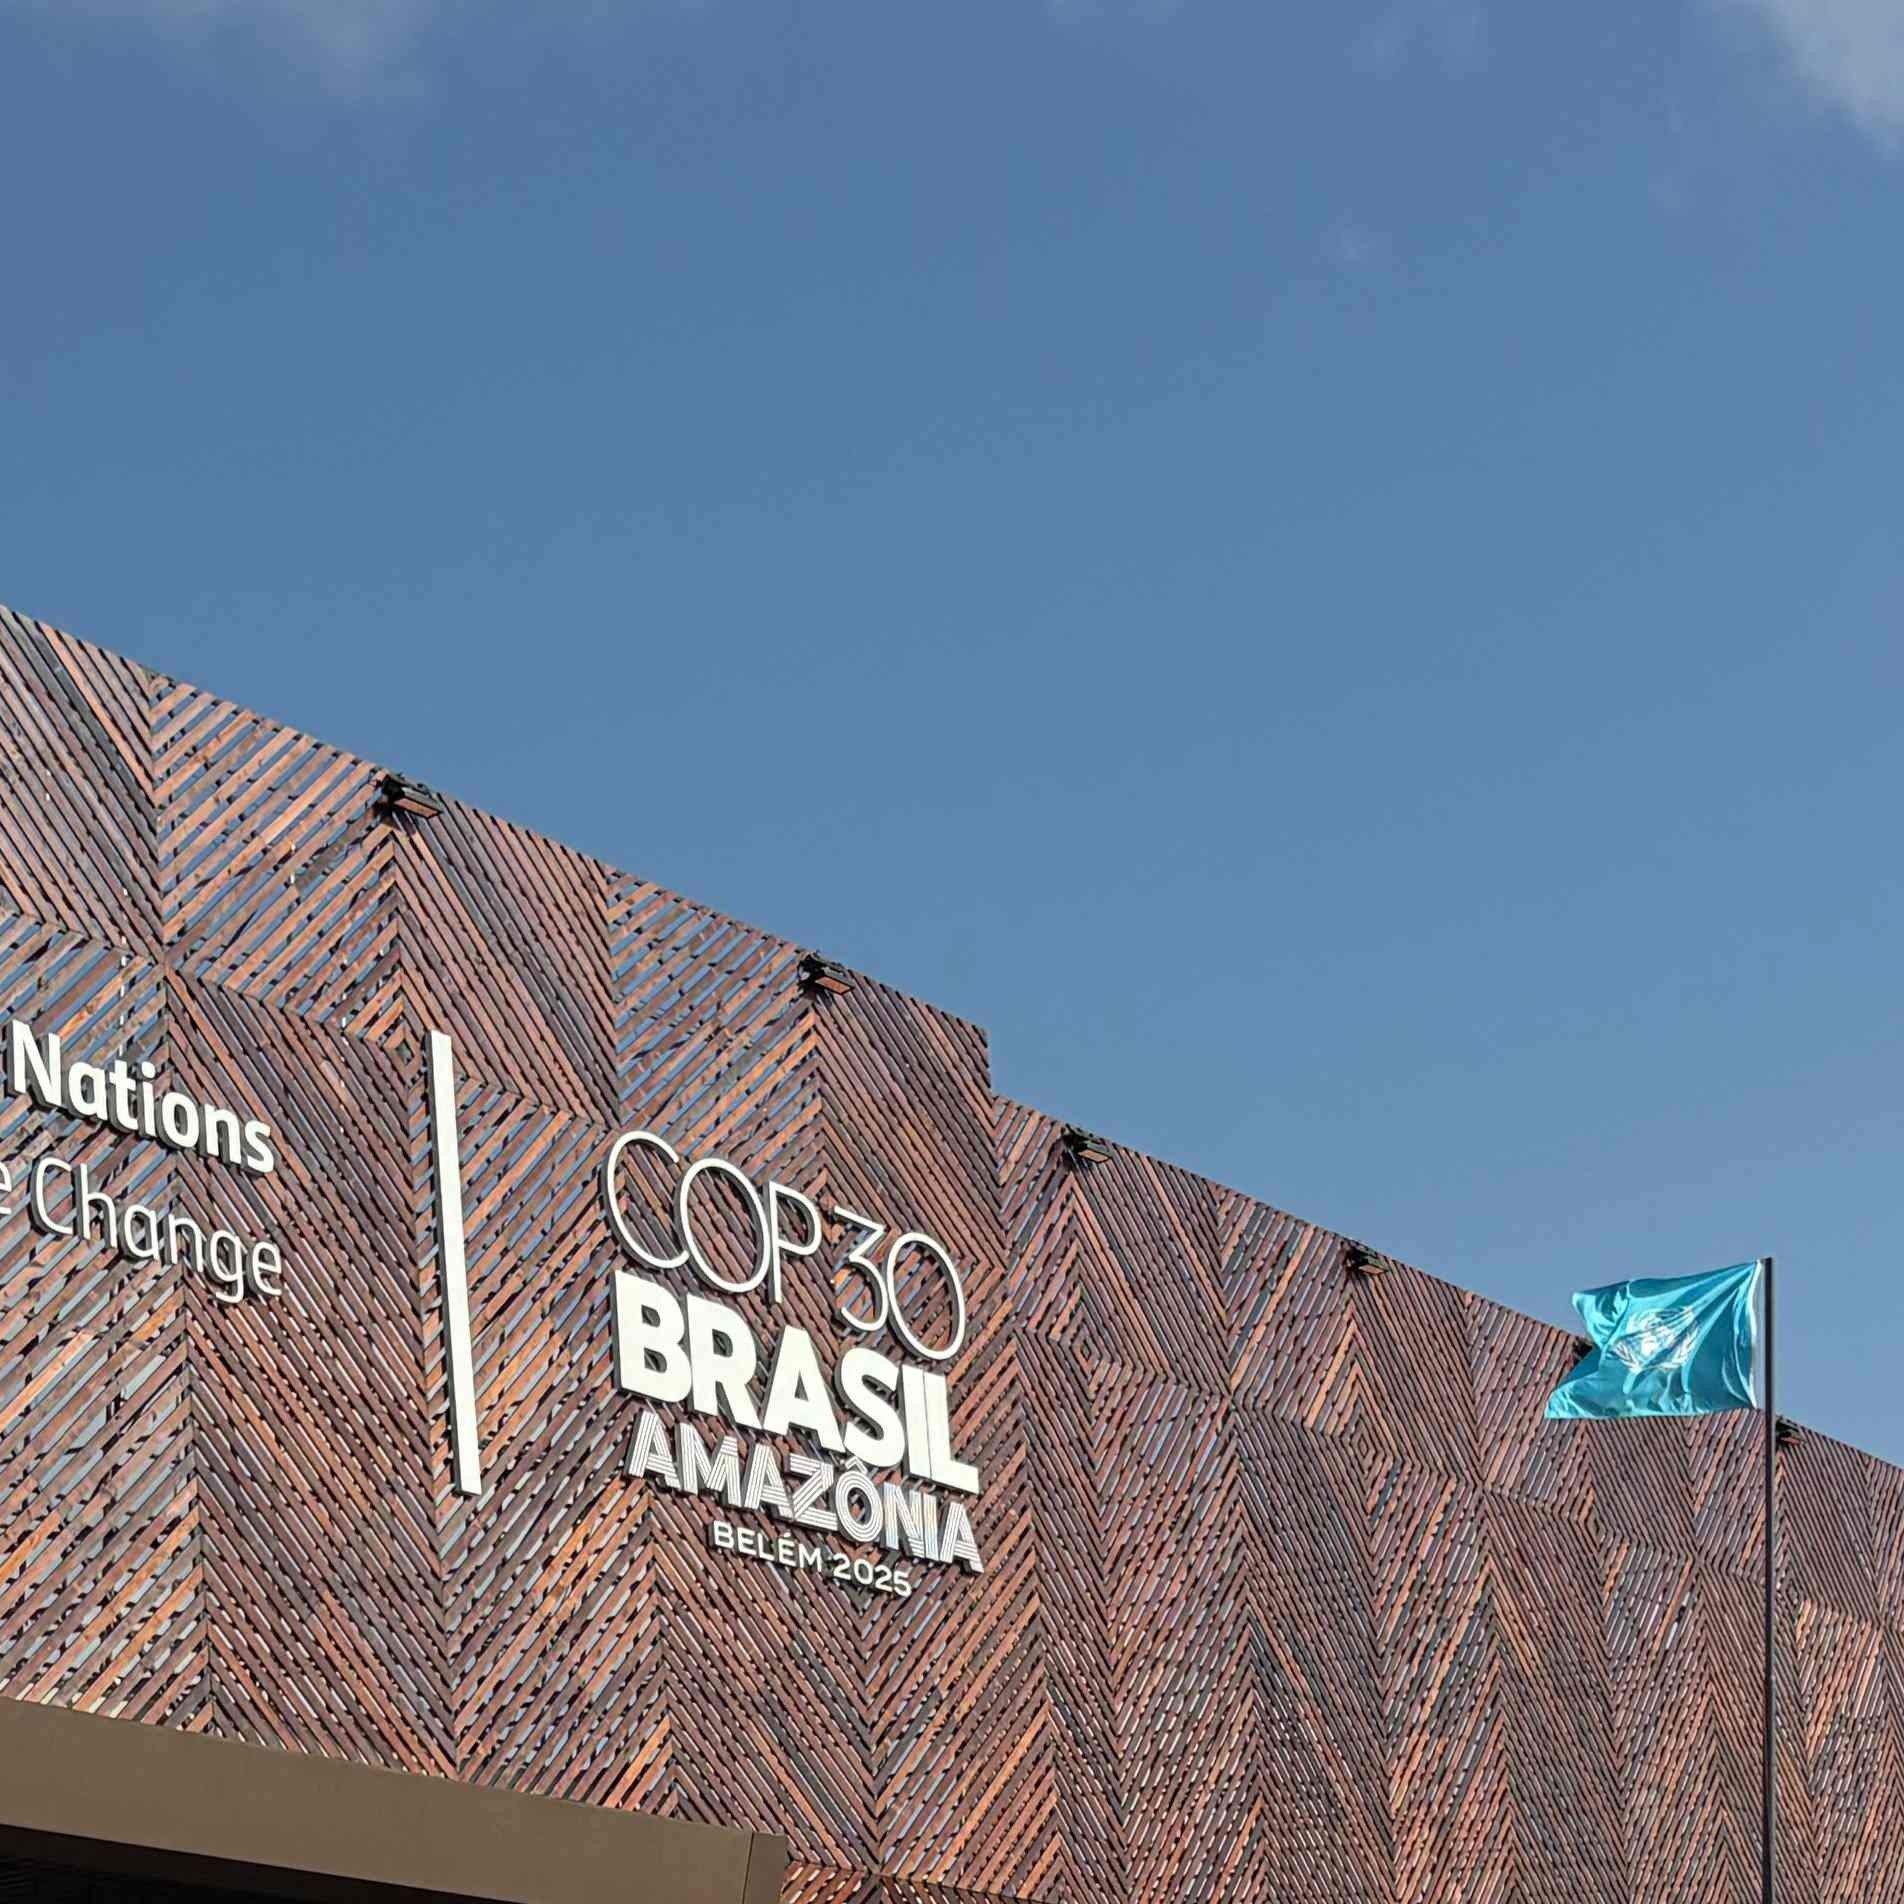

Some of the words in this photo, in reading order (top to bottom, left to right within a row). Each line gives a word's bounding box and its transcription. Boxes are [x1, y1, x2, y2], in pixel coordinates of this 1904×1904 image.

[6, 1019, 276, 1174] Nations
[30, 1157, 283, 1304] Change
[605, 1130, 966, 1360] COP30
[613, 1269, 980, 1495] BRASIL
[627, 1411, 984, 1574] AMAZÔNIA
[711, 1521, 825, 1573] BELÉM
[832, 1552, 913, 1598] 2025
